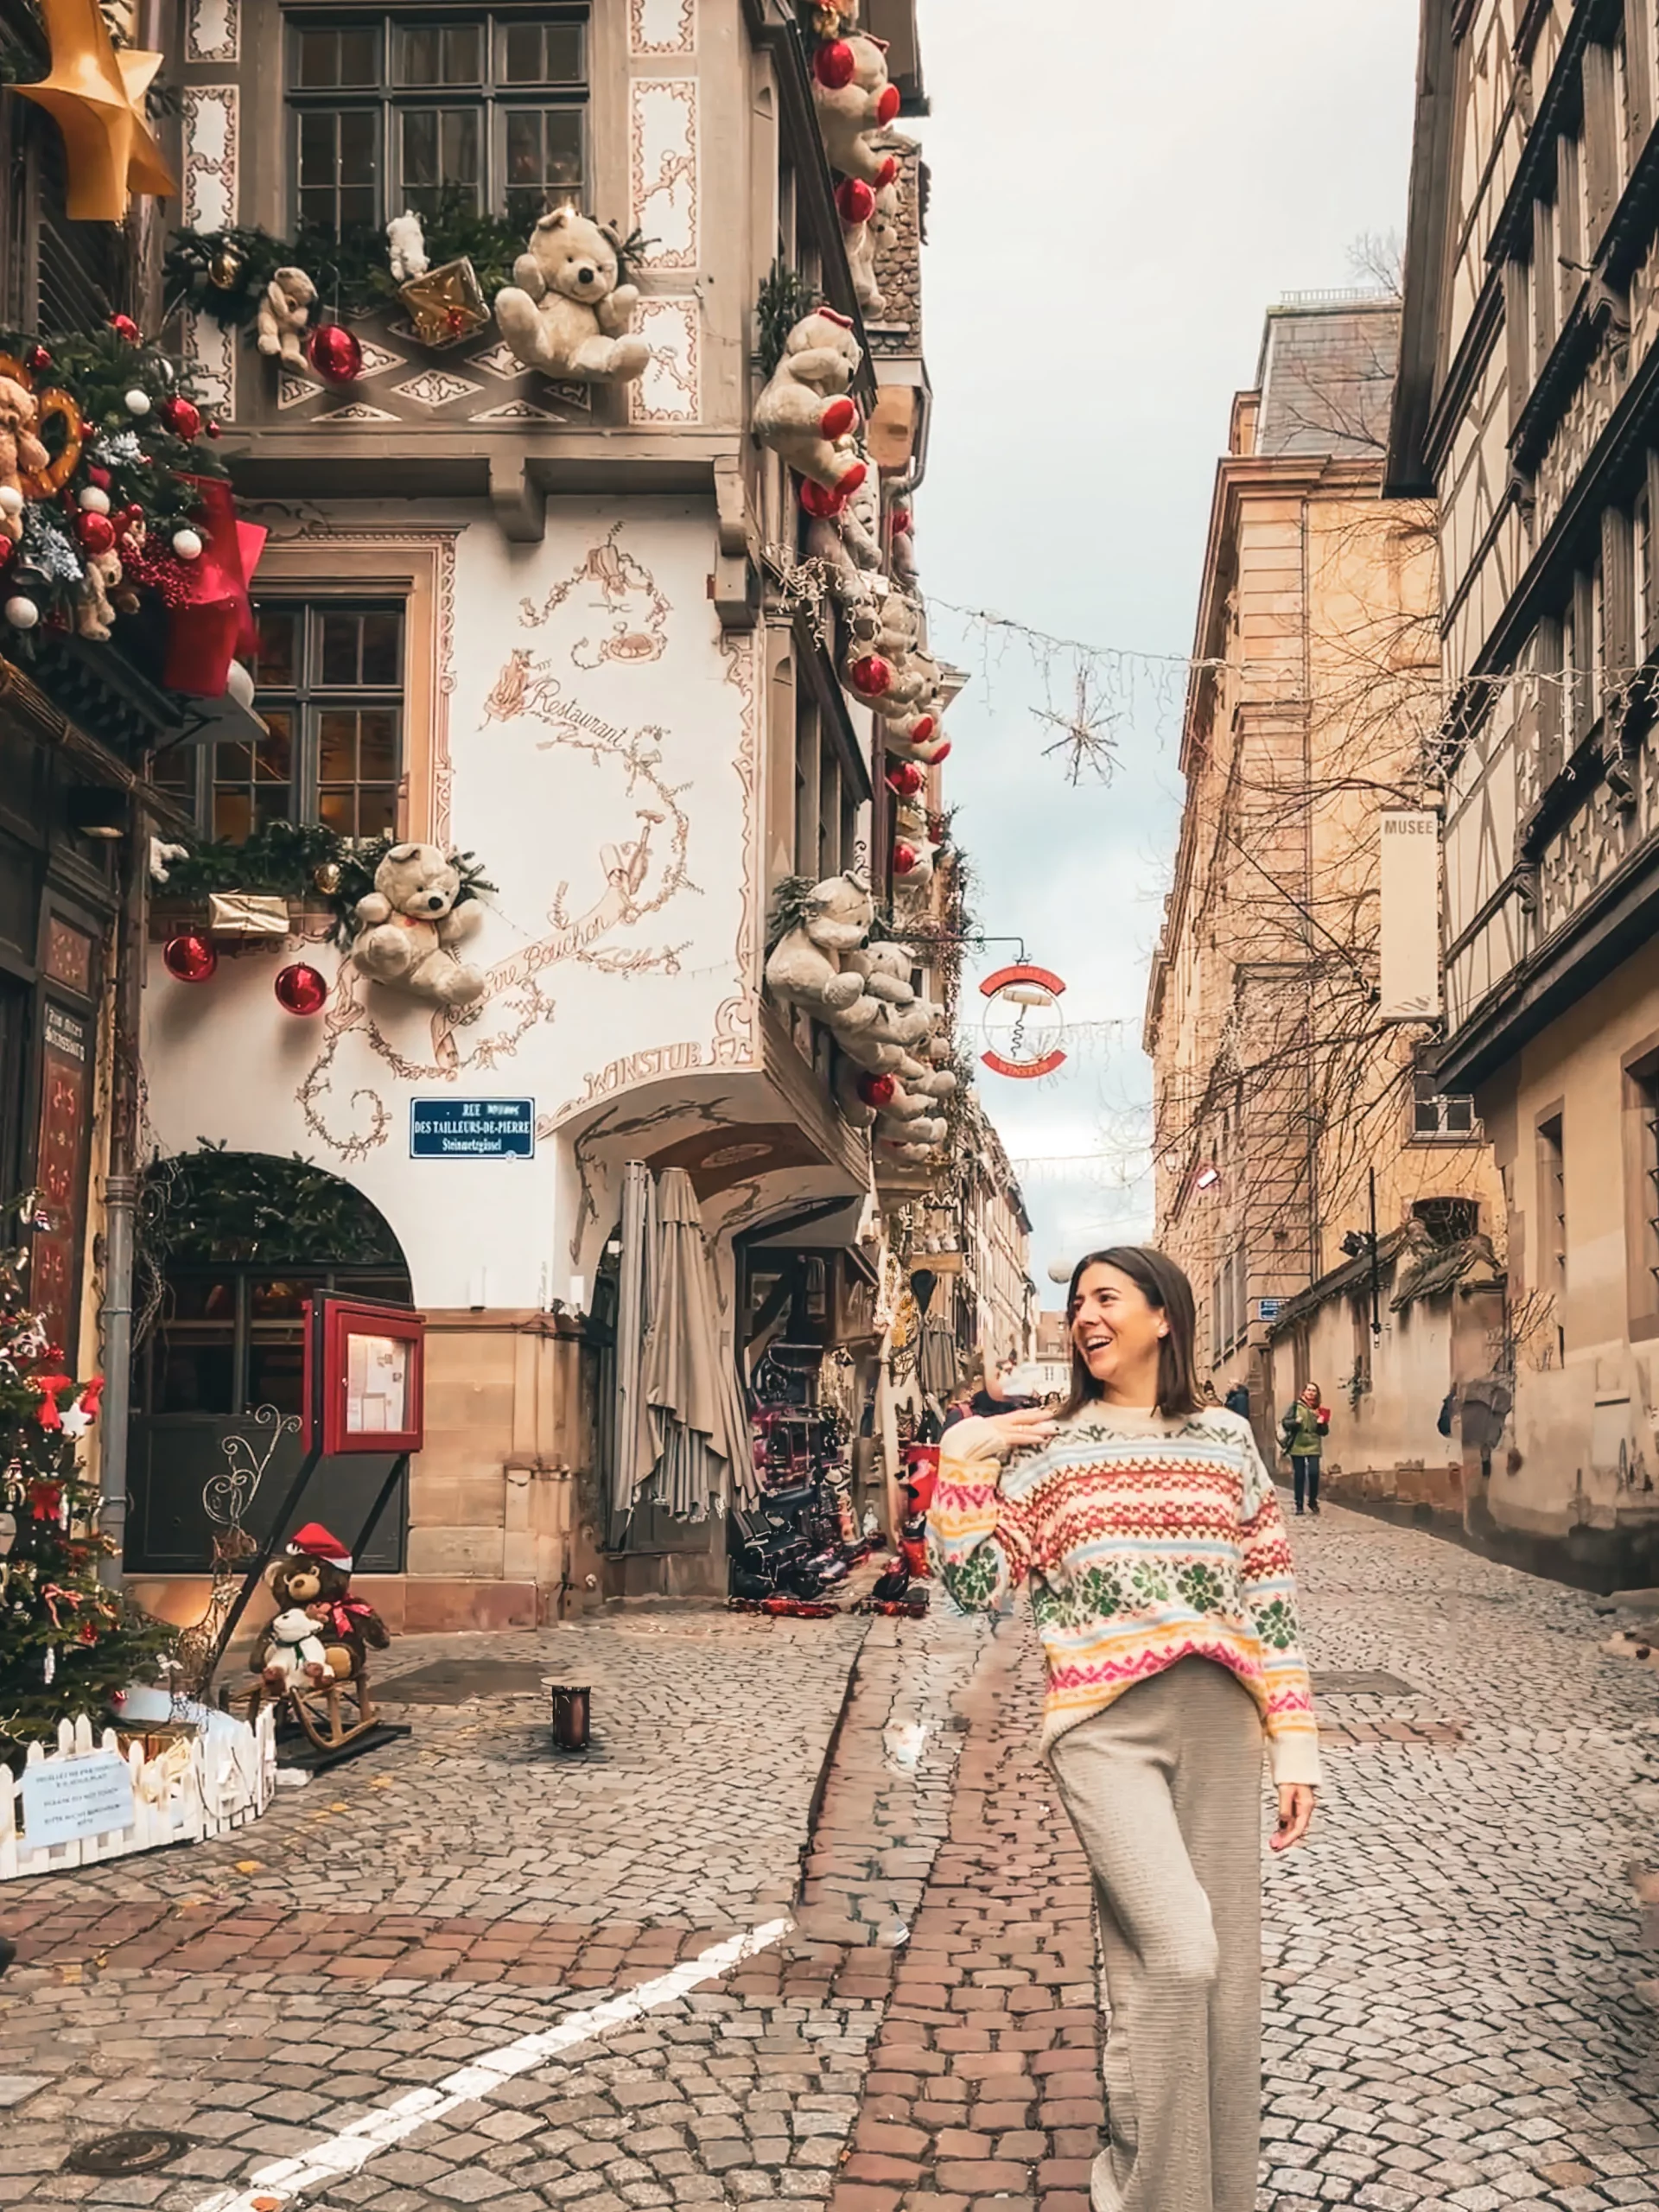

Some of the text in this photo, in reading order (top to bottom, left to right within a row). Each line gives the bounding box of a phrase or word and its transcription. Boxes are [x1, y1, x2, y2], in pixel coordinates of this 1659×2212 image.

[521, 678, 627, 748] Restaurant
[1384, 820, 1433, 835] MUSEE
[523, 916, 608, 975] Bouchon
[583, 1042, 702, 1100] WINSTUB
[415, 1120, 530, 1134] DES TAILLEURS-DE-PIERRE
[462, 1103, 481, 1116] RUE
